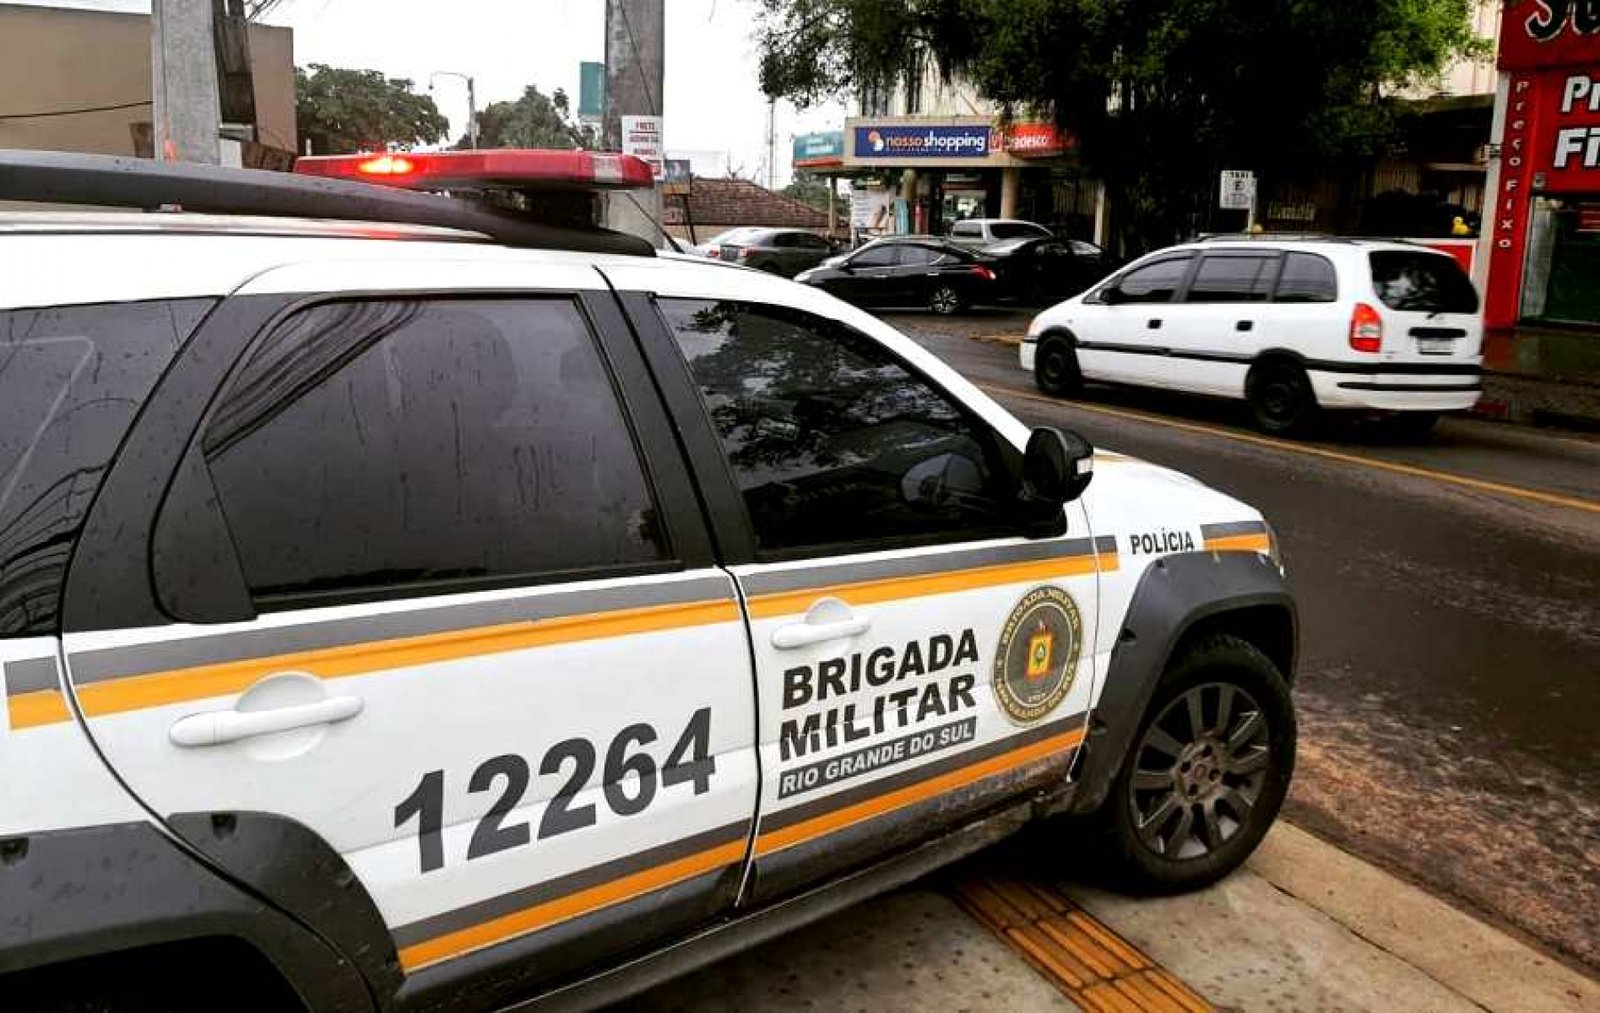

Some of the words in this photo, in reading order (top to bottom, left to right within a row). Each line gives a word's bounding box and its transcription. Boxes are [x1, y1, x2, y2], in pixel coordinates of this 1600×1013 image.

[1129, 527, 1195, 555] POLÍCIA
[781, 628, 979, 710] BRIGADA
[779, 673, 977, 762] MILITAR
[782, 767, 819, 794] RIO
[825, 741, 905, 780] GRANDE
[909, 732, 934, 755] DO
[939, 722, 972, 746] SUL
[394, 706, 716, 874] 12264
